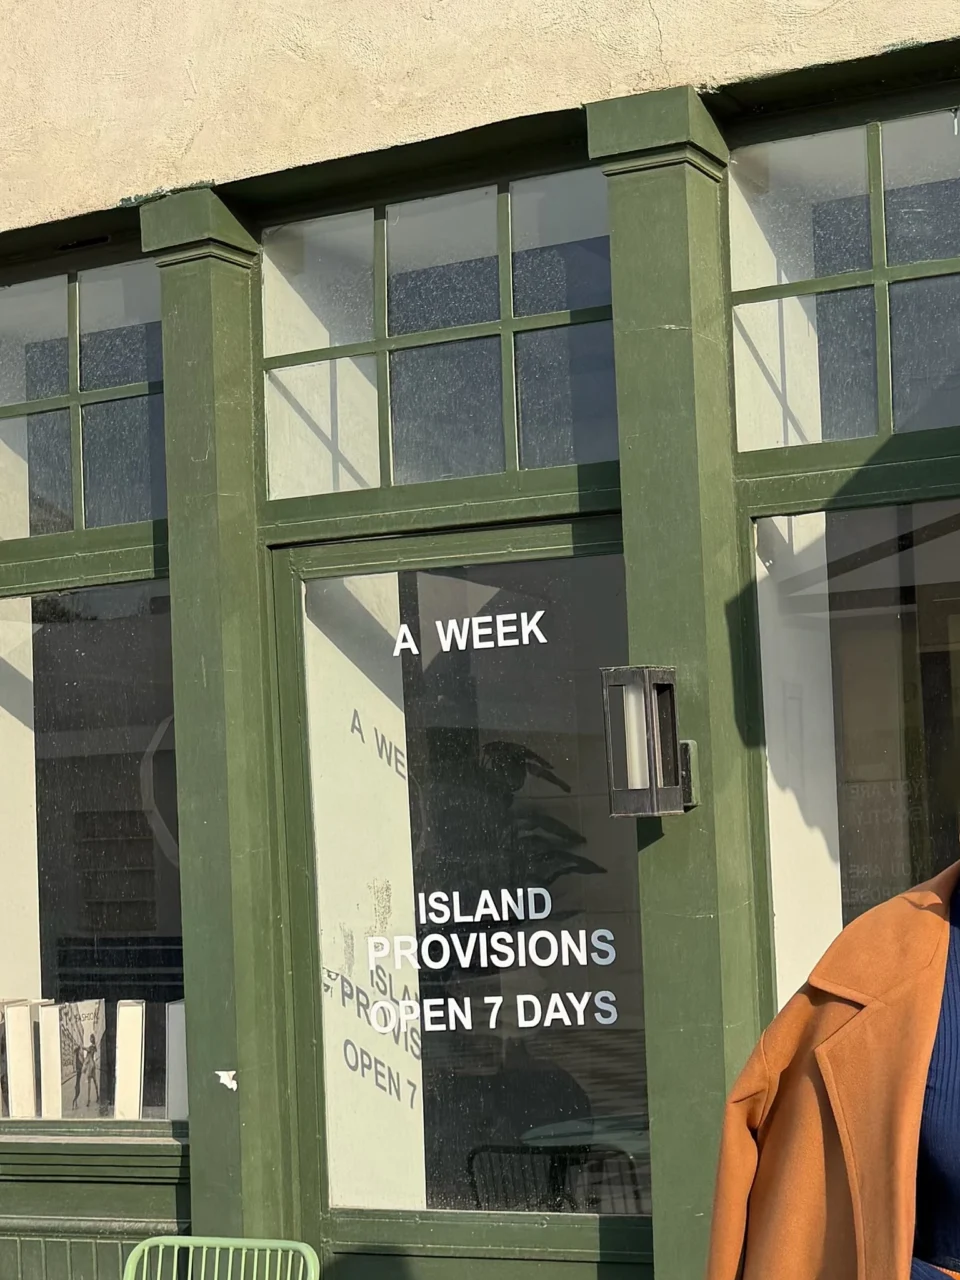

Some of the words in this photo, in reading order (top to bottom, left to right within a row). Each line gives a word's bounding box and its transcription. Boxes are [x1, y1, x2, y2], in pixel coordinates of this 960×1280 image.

[393, 624, 419, 657] A
[435, 610, 548, 652] WEEK
[418, 887, 552, 925] ISLAND
[367, 929, 616, 970] PROVISIONS
[369, 995, 472, 1034] OPEN
[484, 996, 504, 1029] 7
[516, 990, 618, 1028] DAYS
[343, 1039, 401, 1101] OPEN
